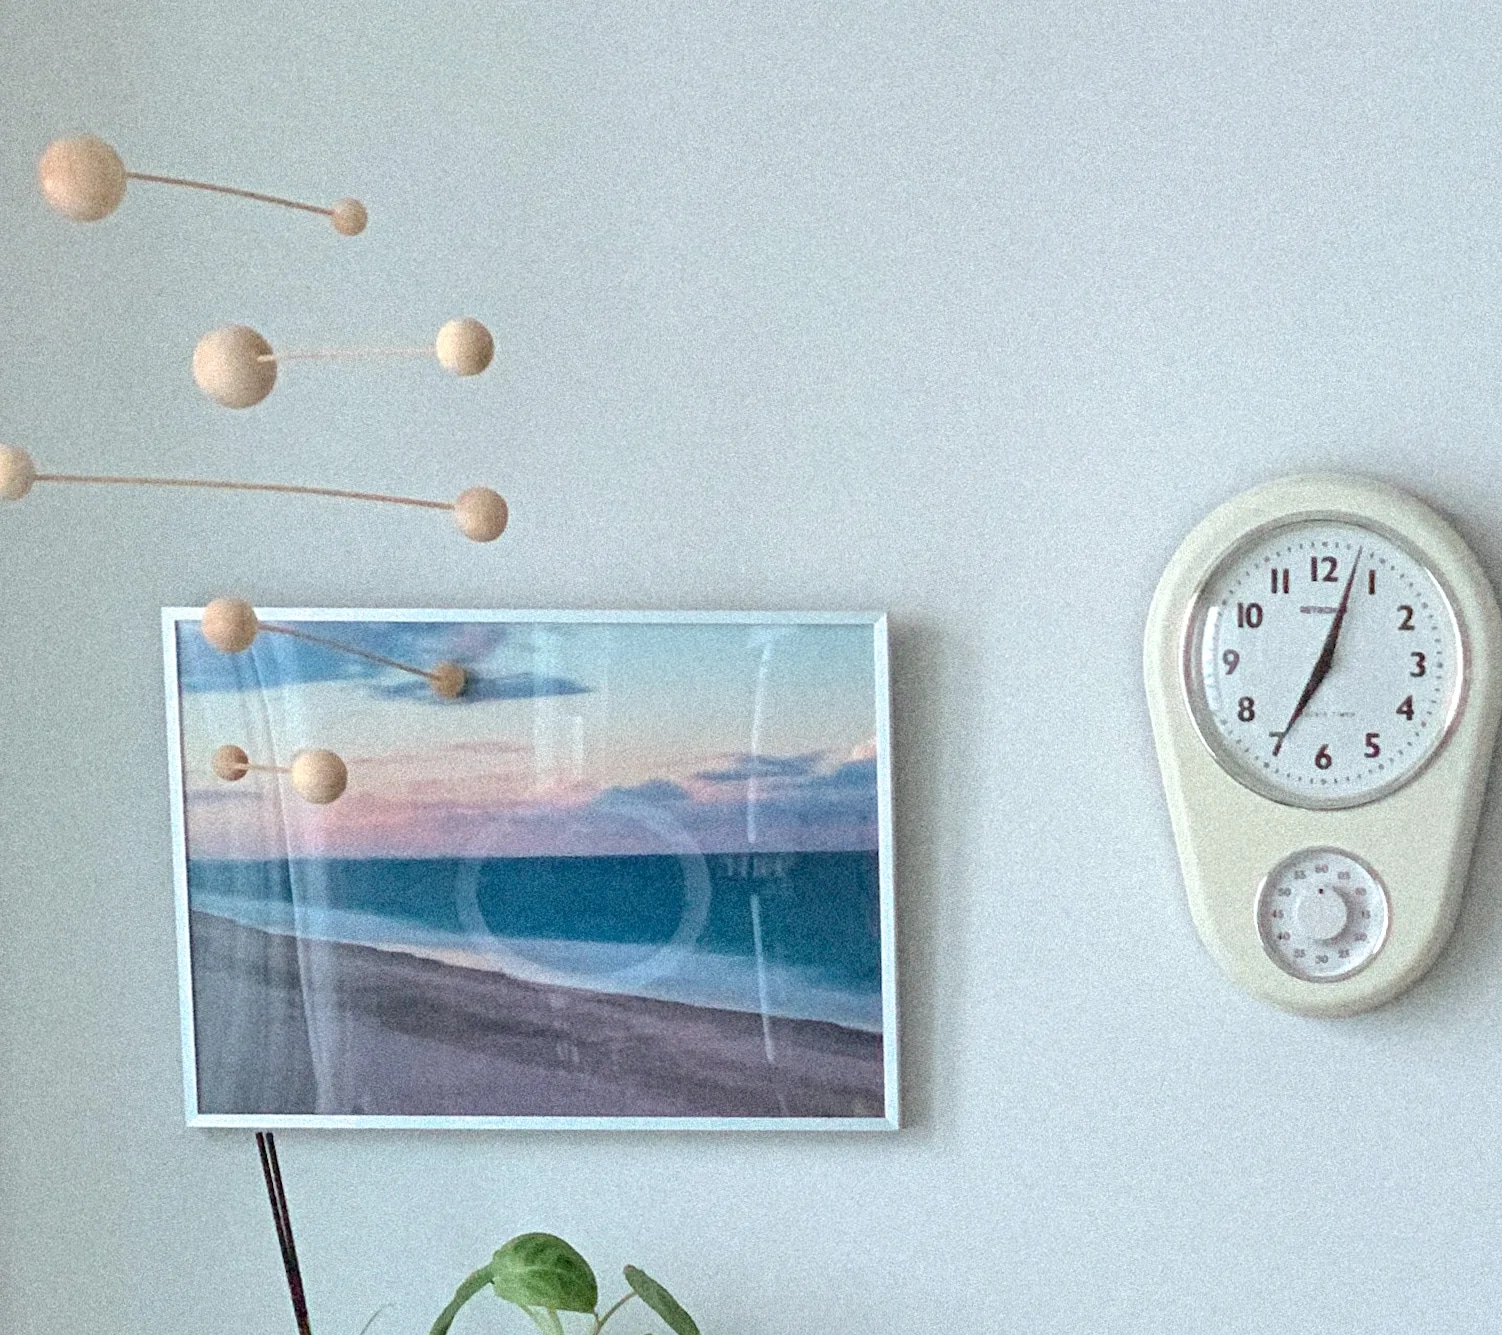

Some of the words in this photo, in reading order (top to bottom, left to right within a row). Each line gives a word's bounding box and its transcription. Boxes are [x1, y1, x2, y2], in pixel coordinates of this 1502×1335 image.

[1271, 568, 1290, 594] 11
[1310, 556, 1338, 582] 12
[1368, 569, 1376, 595] 1
[1237, 602, 1263, 629] 10
[1397, 605, 1415, 631] 2
[1222, 649, 1240, 675] 9
[1410, 651, 1426, 677] 3
[1237, 696, 1255, 722] 8
[1396, 695, 1415, 721] 4
[1269, 731, 1286, 757] 7
[1315, 743, 1332, 770] 6
[1364, 733, 1381, 758] 5
